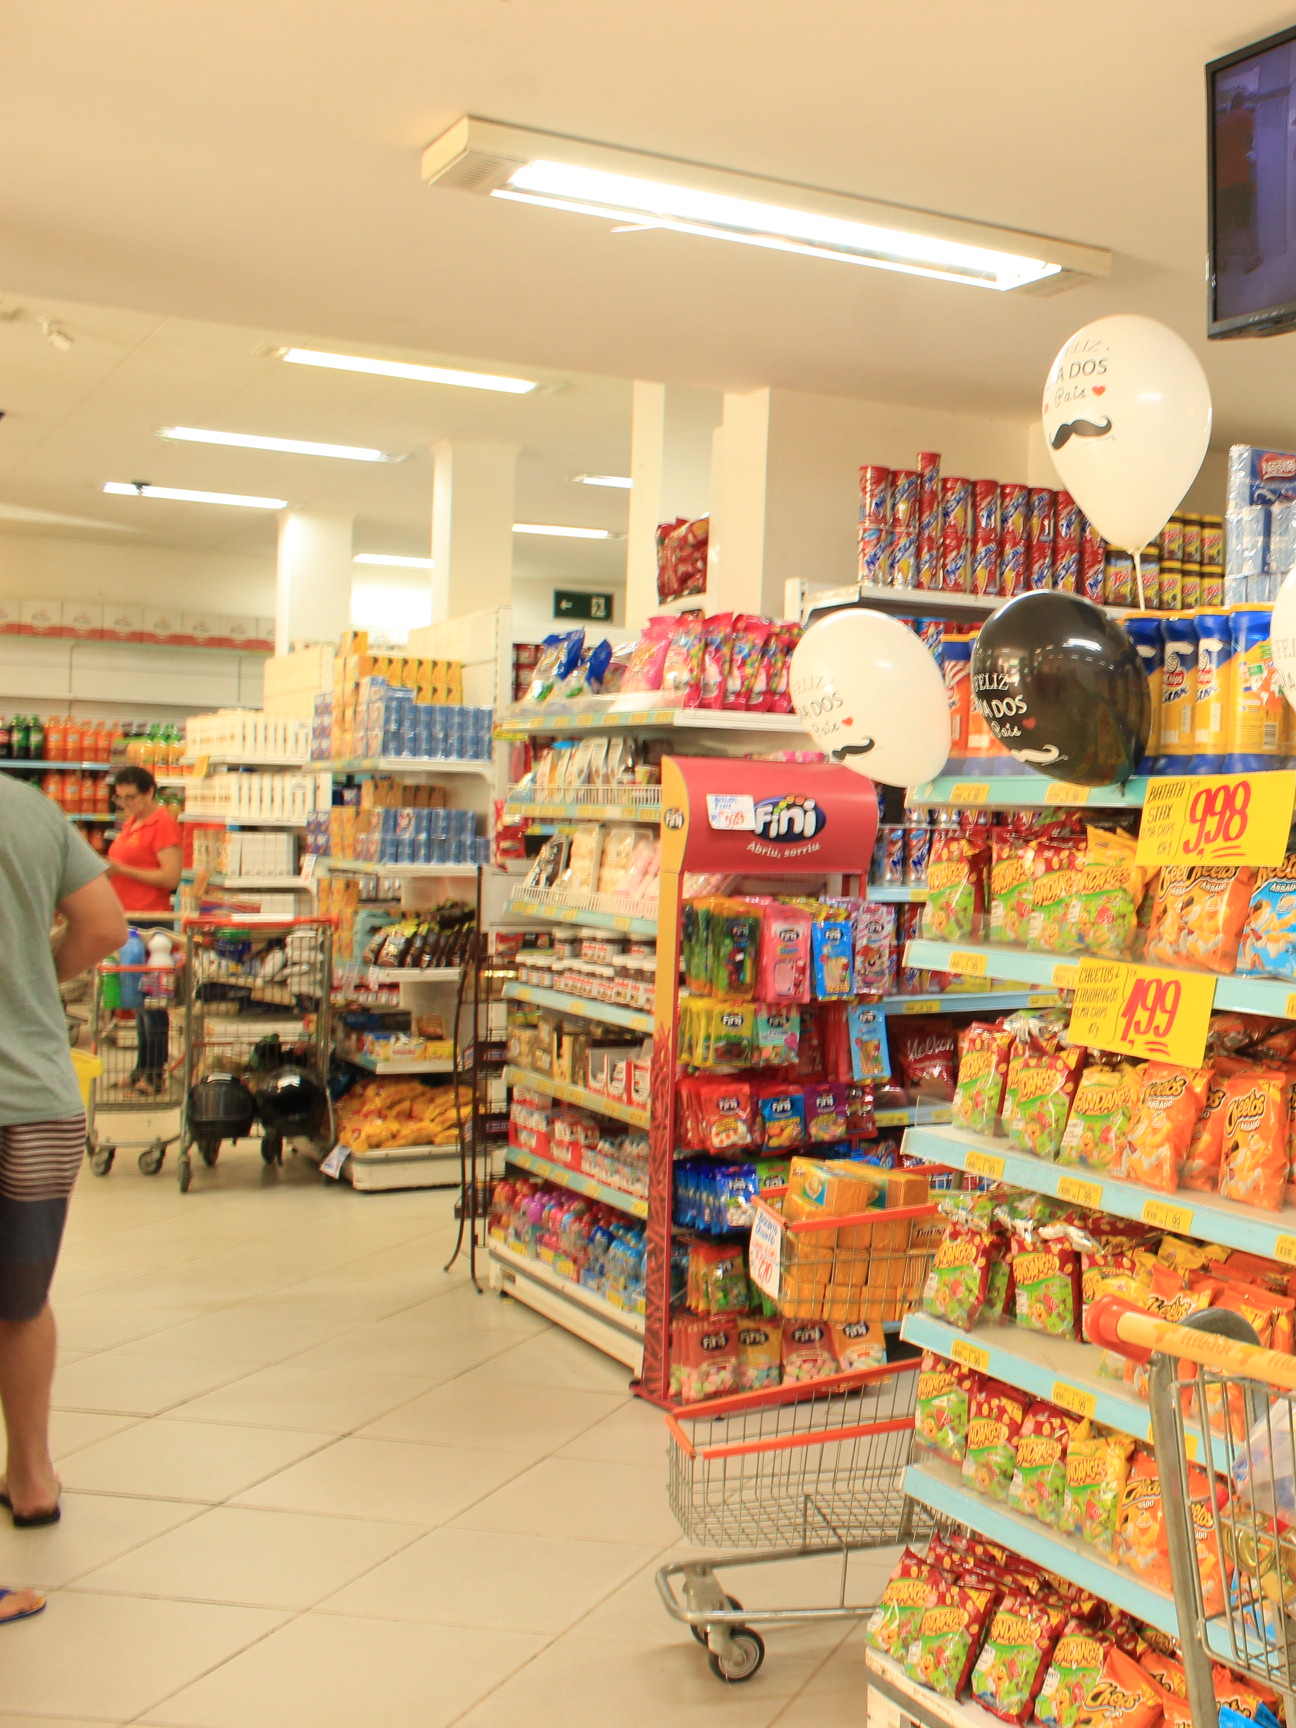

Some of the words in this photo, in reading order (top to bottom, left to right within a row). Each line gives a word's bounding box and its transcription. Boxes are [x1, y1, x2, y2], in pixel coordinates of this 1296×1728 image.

[1068, 357, 1108, 381] DOS
[810, 690, 844, 718] DOS
[991, 694, 1028, 718] DOS
[1147, 780, 1186, 804] BATATA
[664, 810, 685, 827] Fini
[754, 798, 817, 839] Fini
[1147, 801, 1173, 824] STAX
[746, 840, 781, 858] Abriu,
[783, 841, 821, 858] sorriu
[779, 929, 799, 942] Fini
[824, 929, 844, 942] Fini
[1078, 966, 1113, 984] CHEETOS
[1073, 986, 1119, 1004] FANDANGOS
[721, 1014, 743, 1027] Fini
[718, 1099, 739, 1112] Fini
[771, 1099, 792, 1113] Fini
[816, 1094, 835, 1109] Fini
[1225, 1088, 1267, 1138] Cheetos
[1164, 1214, 1181, 1230] 1.99
[793, 1327, 823, 1342] Fini
[843, 1323, 867, 1338] Fini
[702, 1334, 728, 1350] Fini
